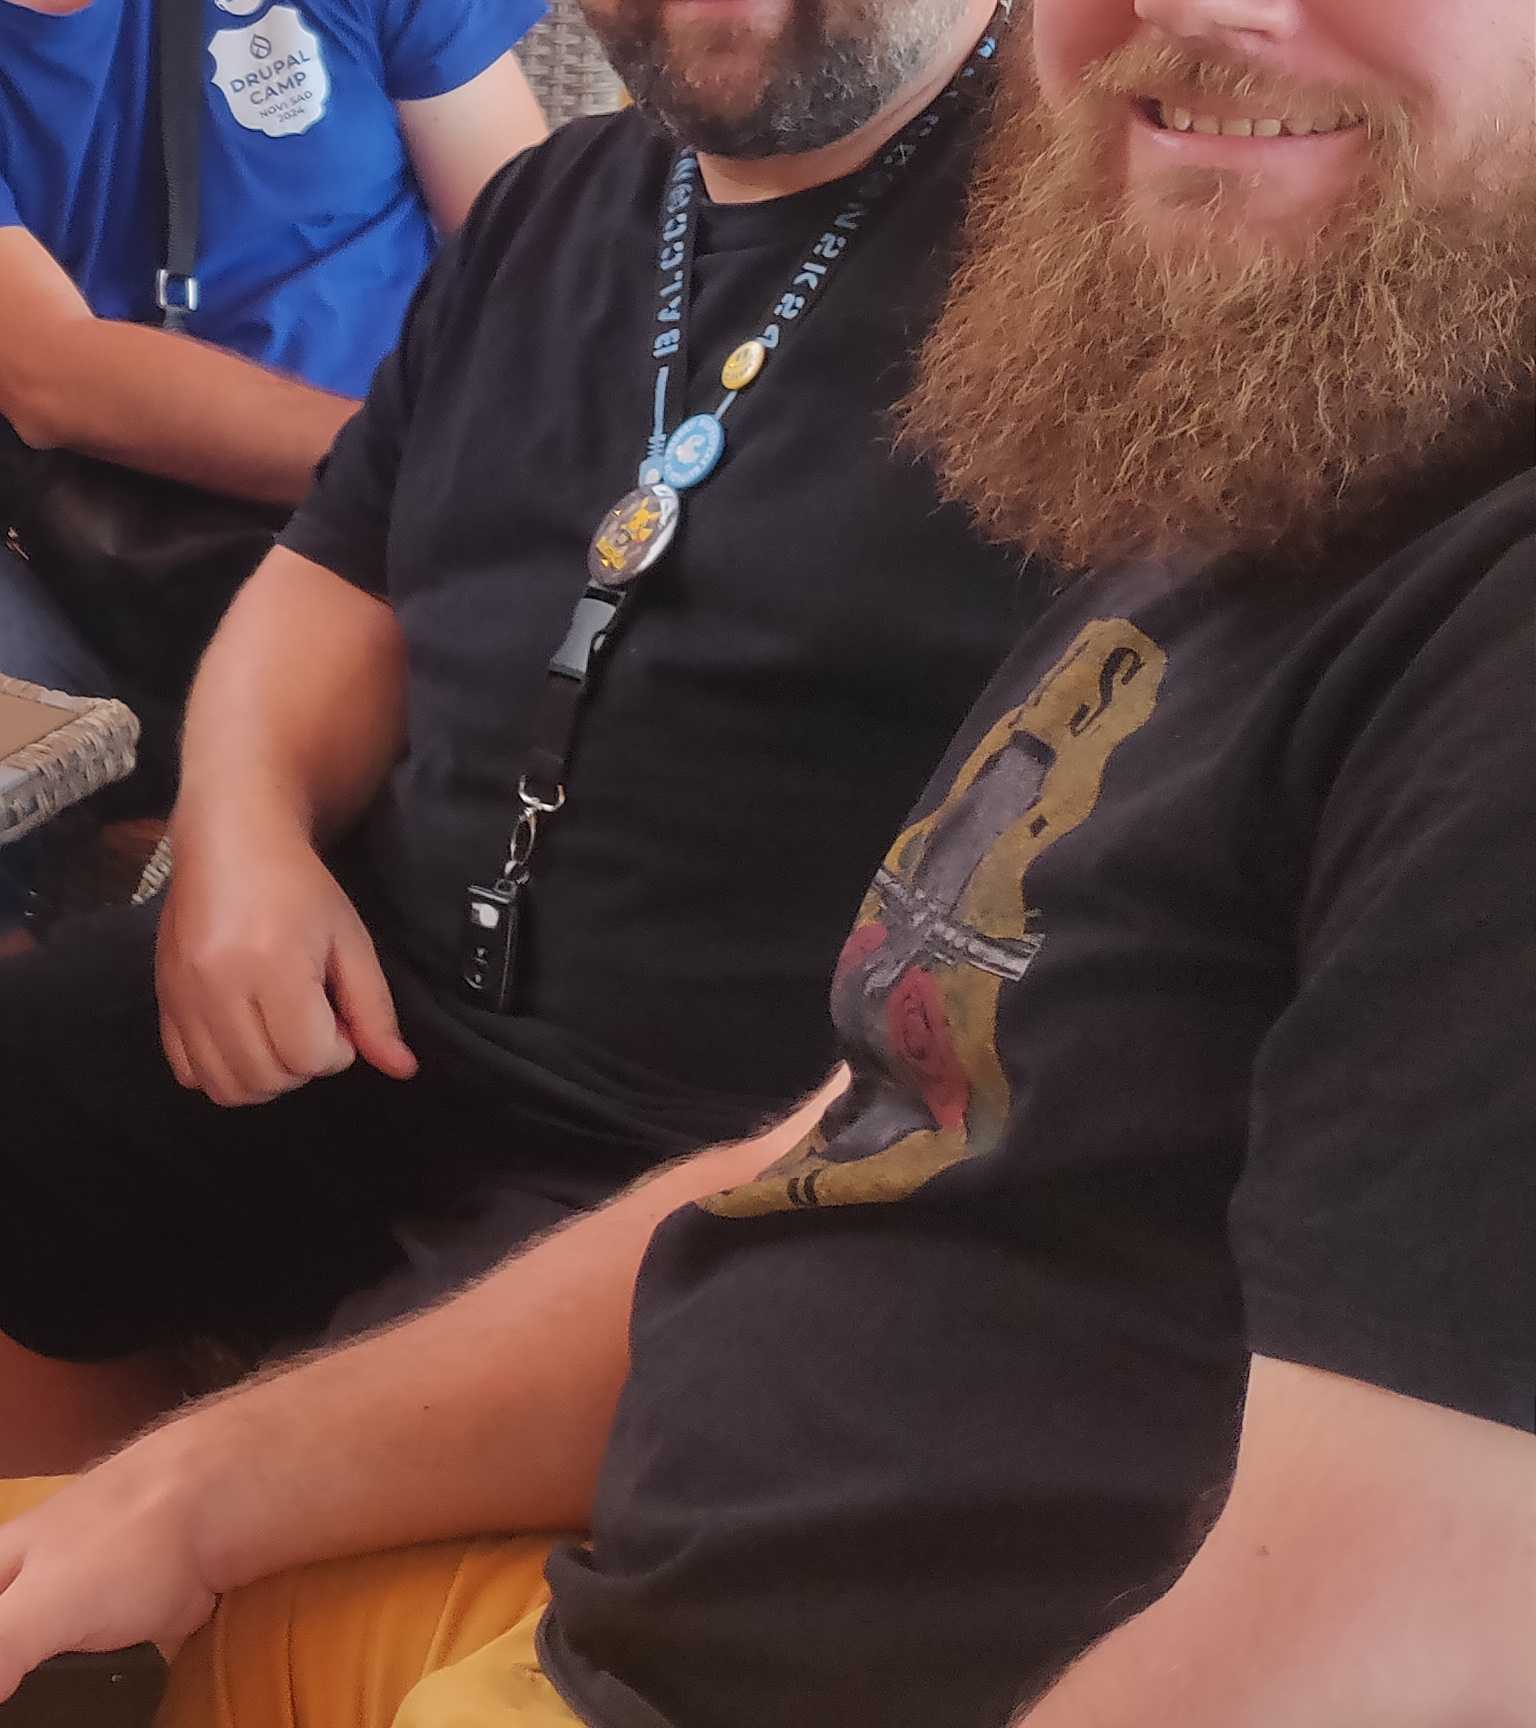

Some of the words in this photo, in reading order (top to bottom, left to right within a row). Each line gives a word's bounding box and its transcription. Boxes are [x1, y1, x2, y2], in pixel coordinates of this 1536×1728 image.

[230, 50, 310, 93] DRUPAL
[250, 72, 306, 105] CAMP
[260, 102, 290, 119] NOVI
[291, 89, 313, 105] SAD
[279, 108, 306, 123] 2024
